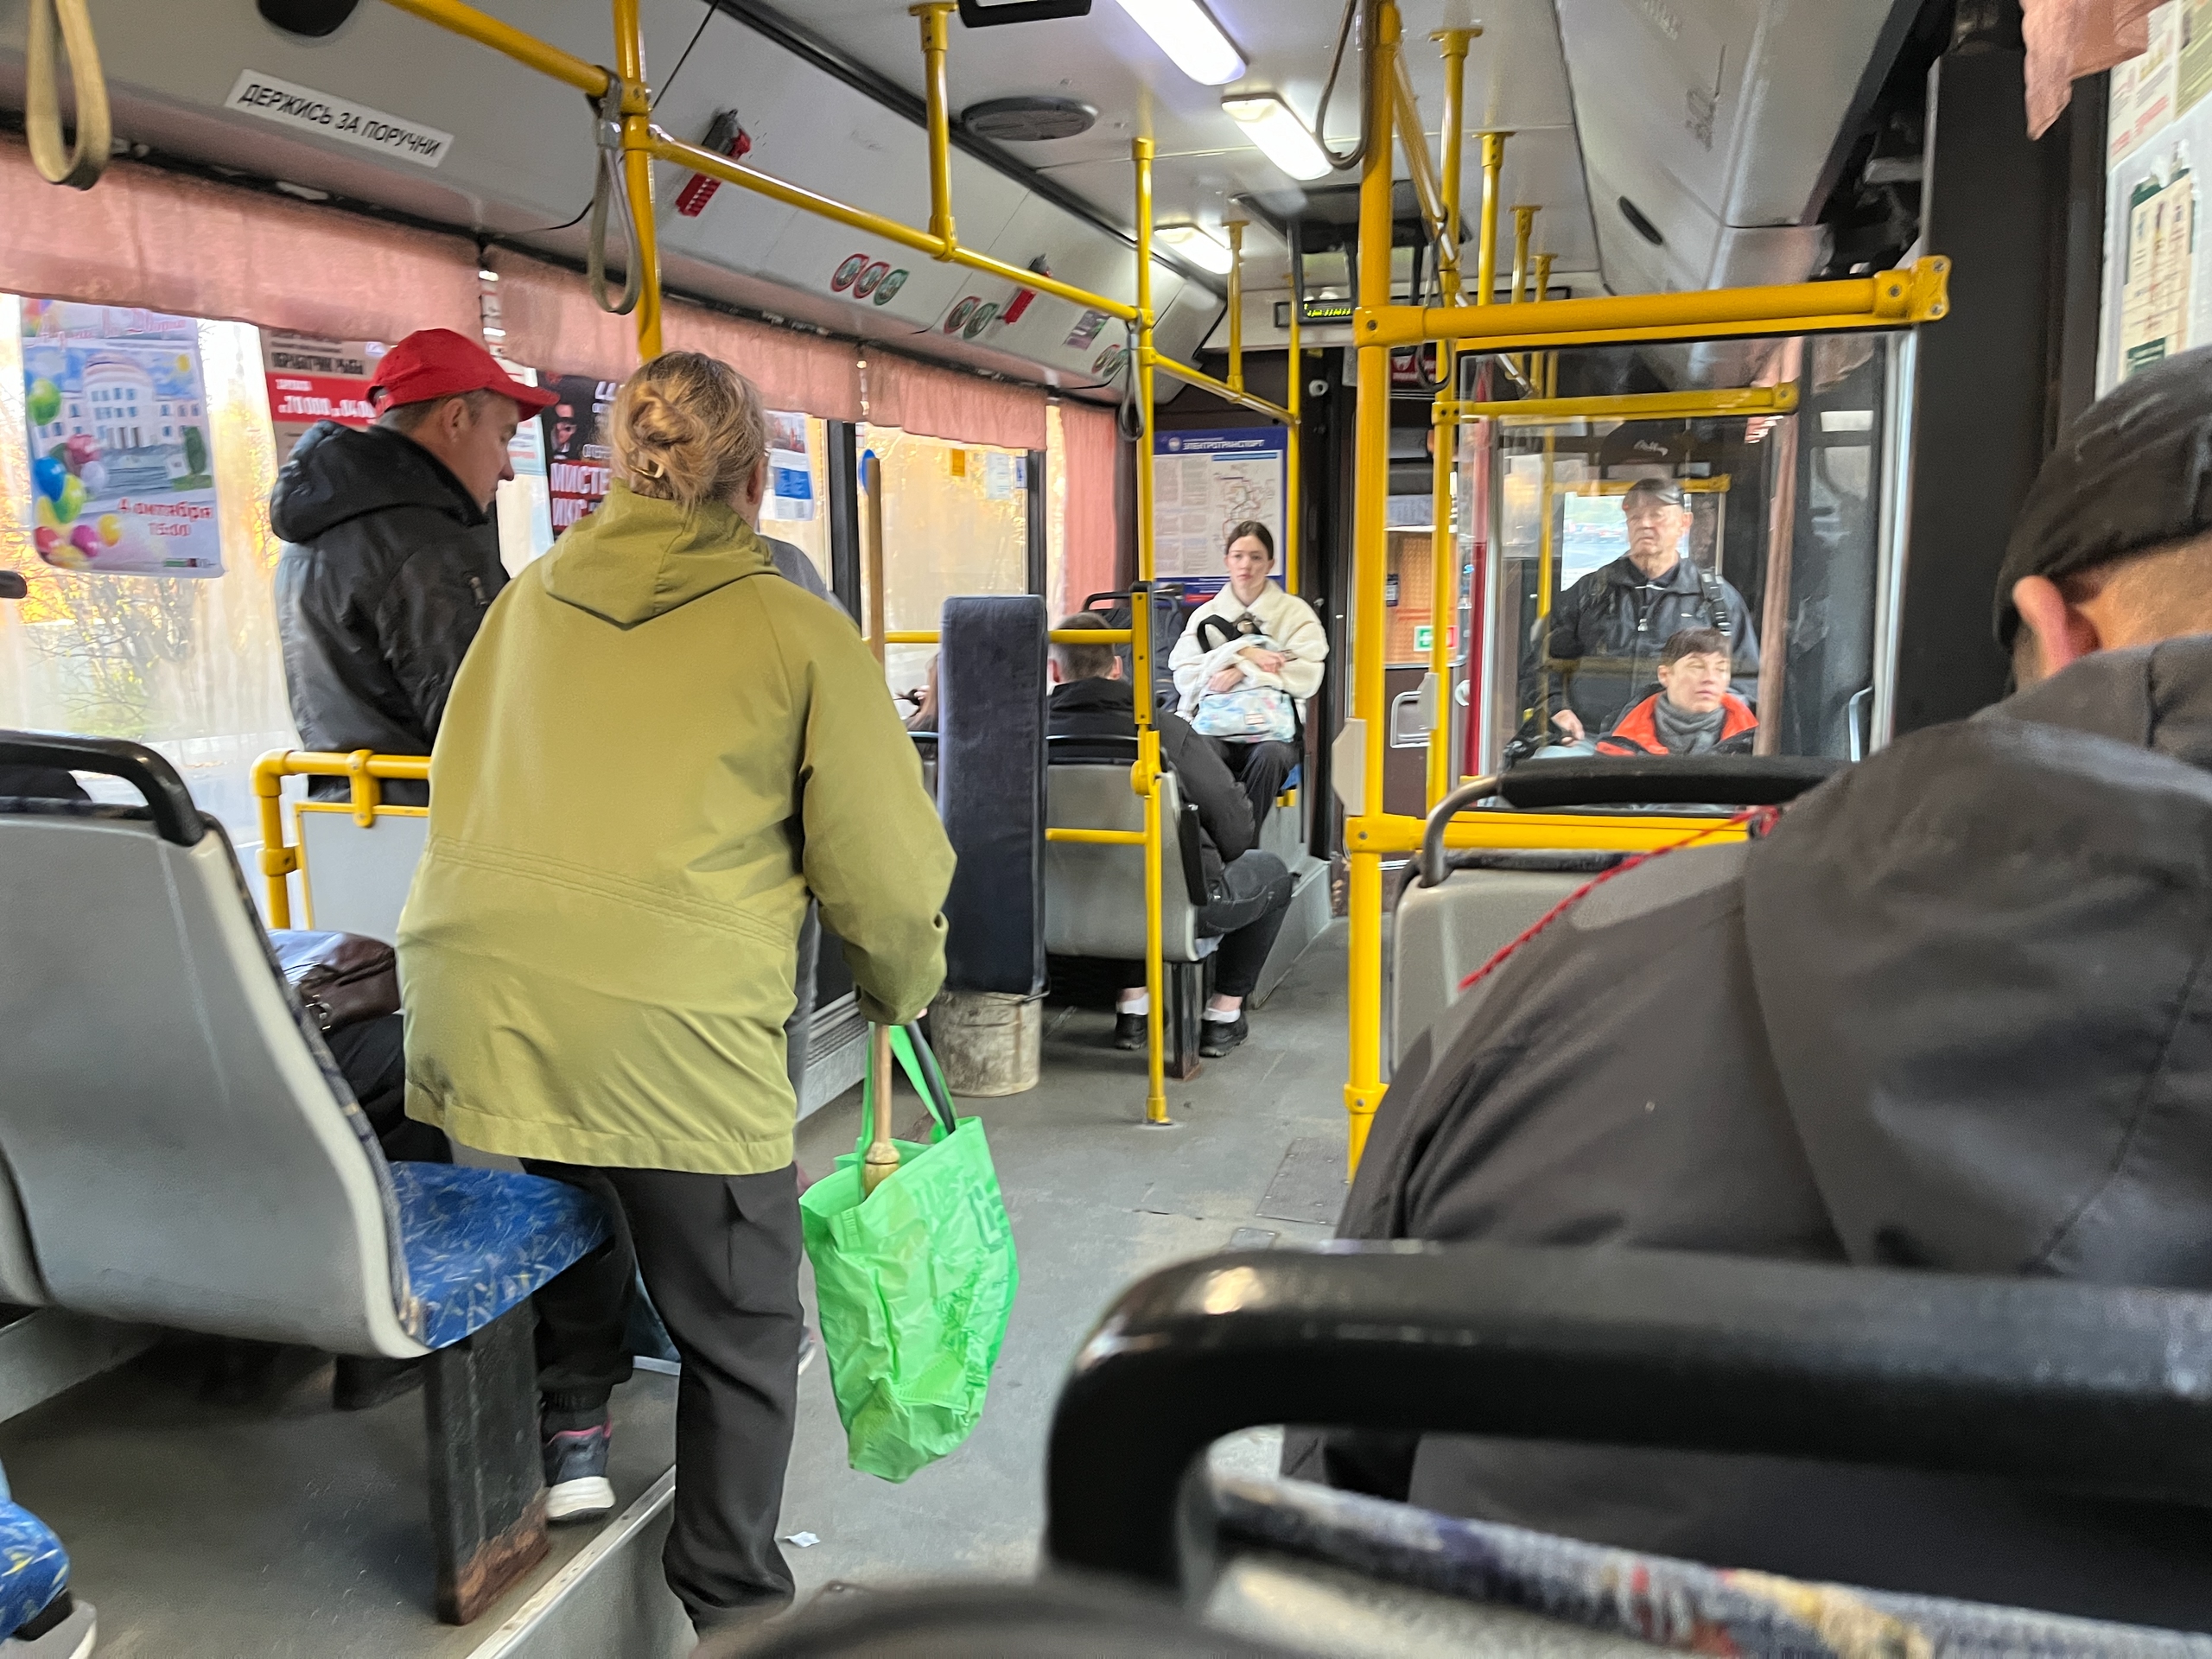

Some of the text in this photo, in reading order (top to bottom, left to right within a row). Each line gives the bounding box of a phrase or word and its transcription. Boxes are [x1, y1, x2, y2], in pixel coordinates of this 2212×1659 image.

[237, 84, 443, 157] ДЕРЖИСЬ ЗА ПОРУЧНИ
[550, 463, 612, 495] МИСТЕ
